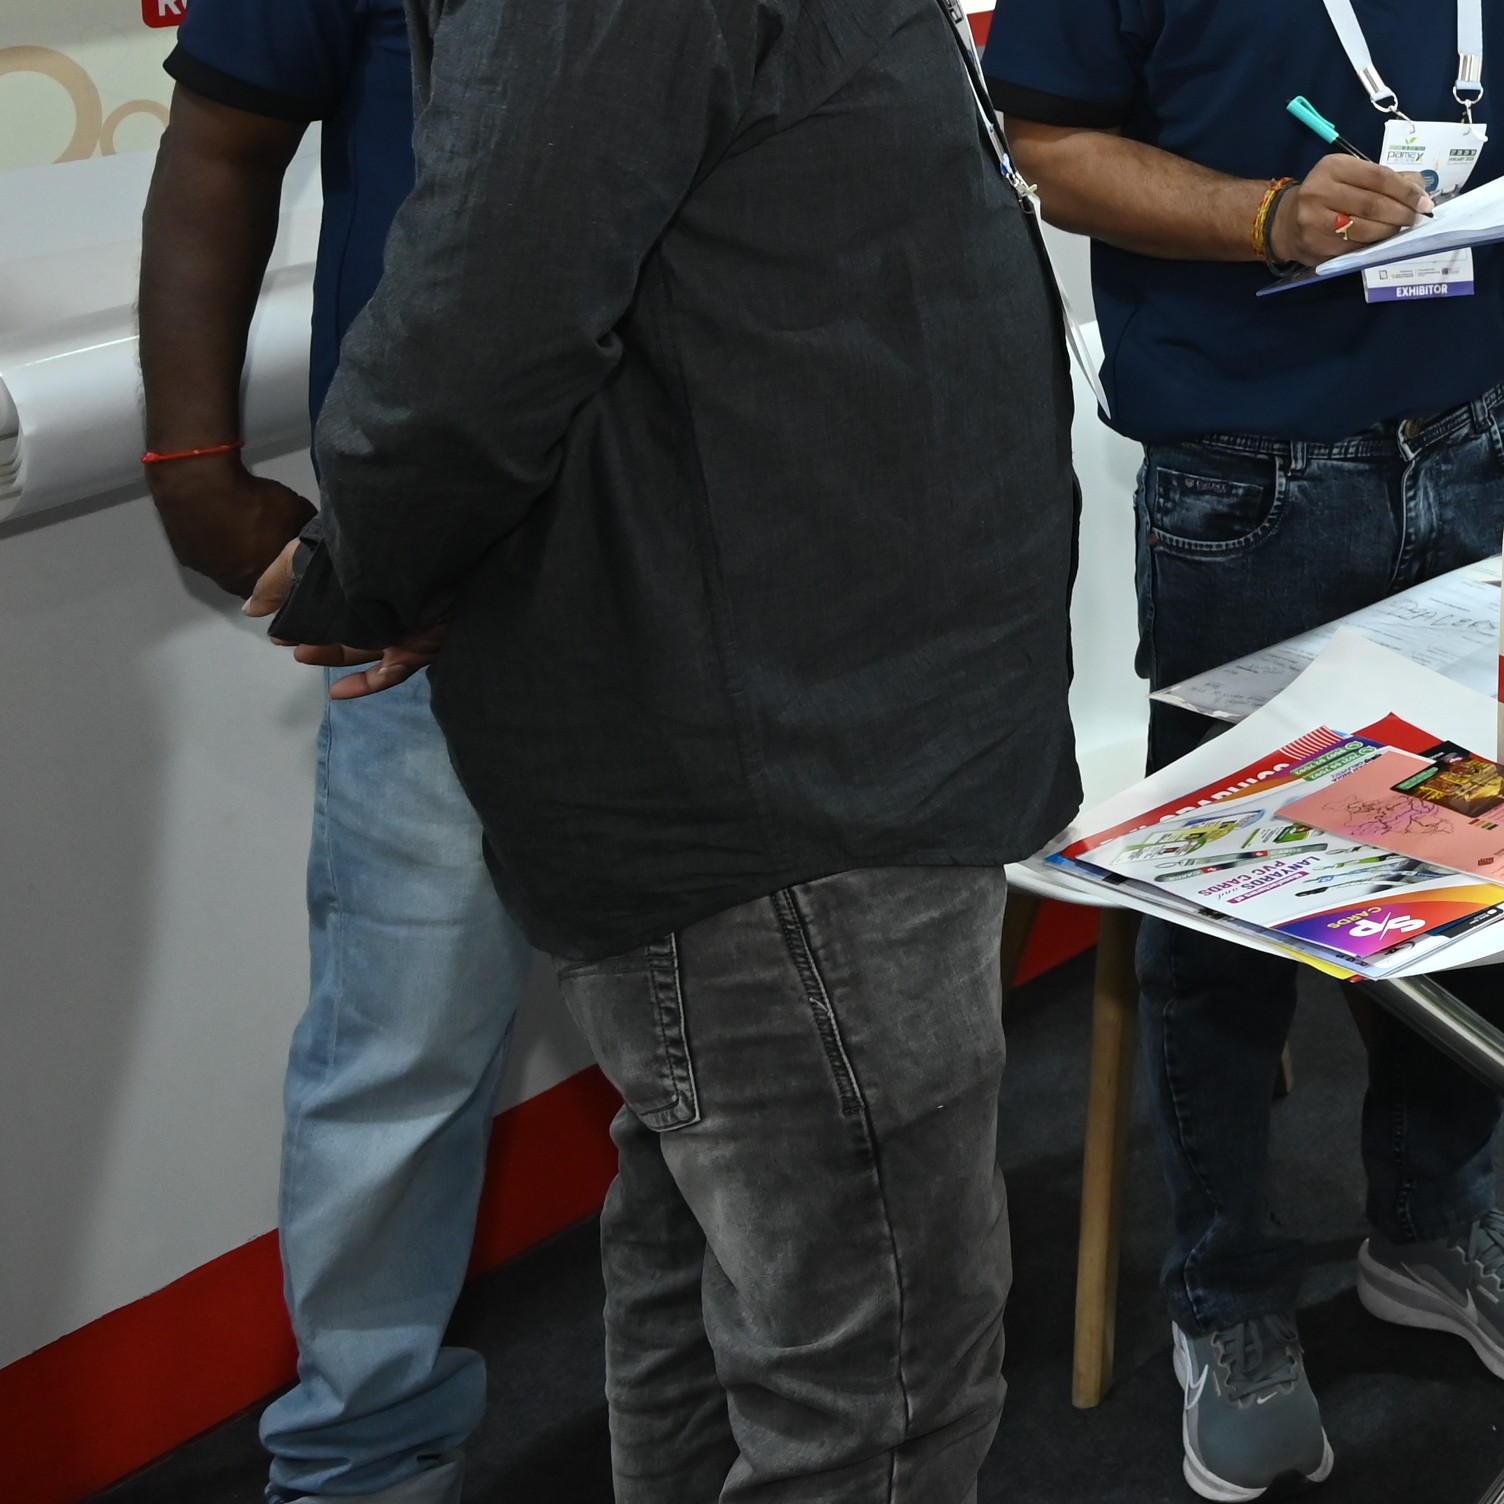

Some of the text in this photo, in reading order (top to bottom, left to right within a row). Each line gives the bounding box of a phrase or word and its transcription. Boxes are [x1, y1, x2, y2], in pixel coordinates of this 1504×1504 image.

[1396, 283, 1448, 298] EXHIBITOR
[1198, 860, 1286, 896] PVC CARDS
[1241, 855, 1321, 890] LANYARDS
[1326, 906, 1382, 929] CARDS
